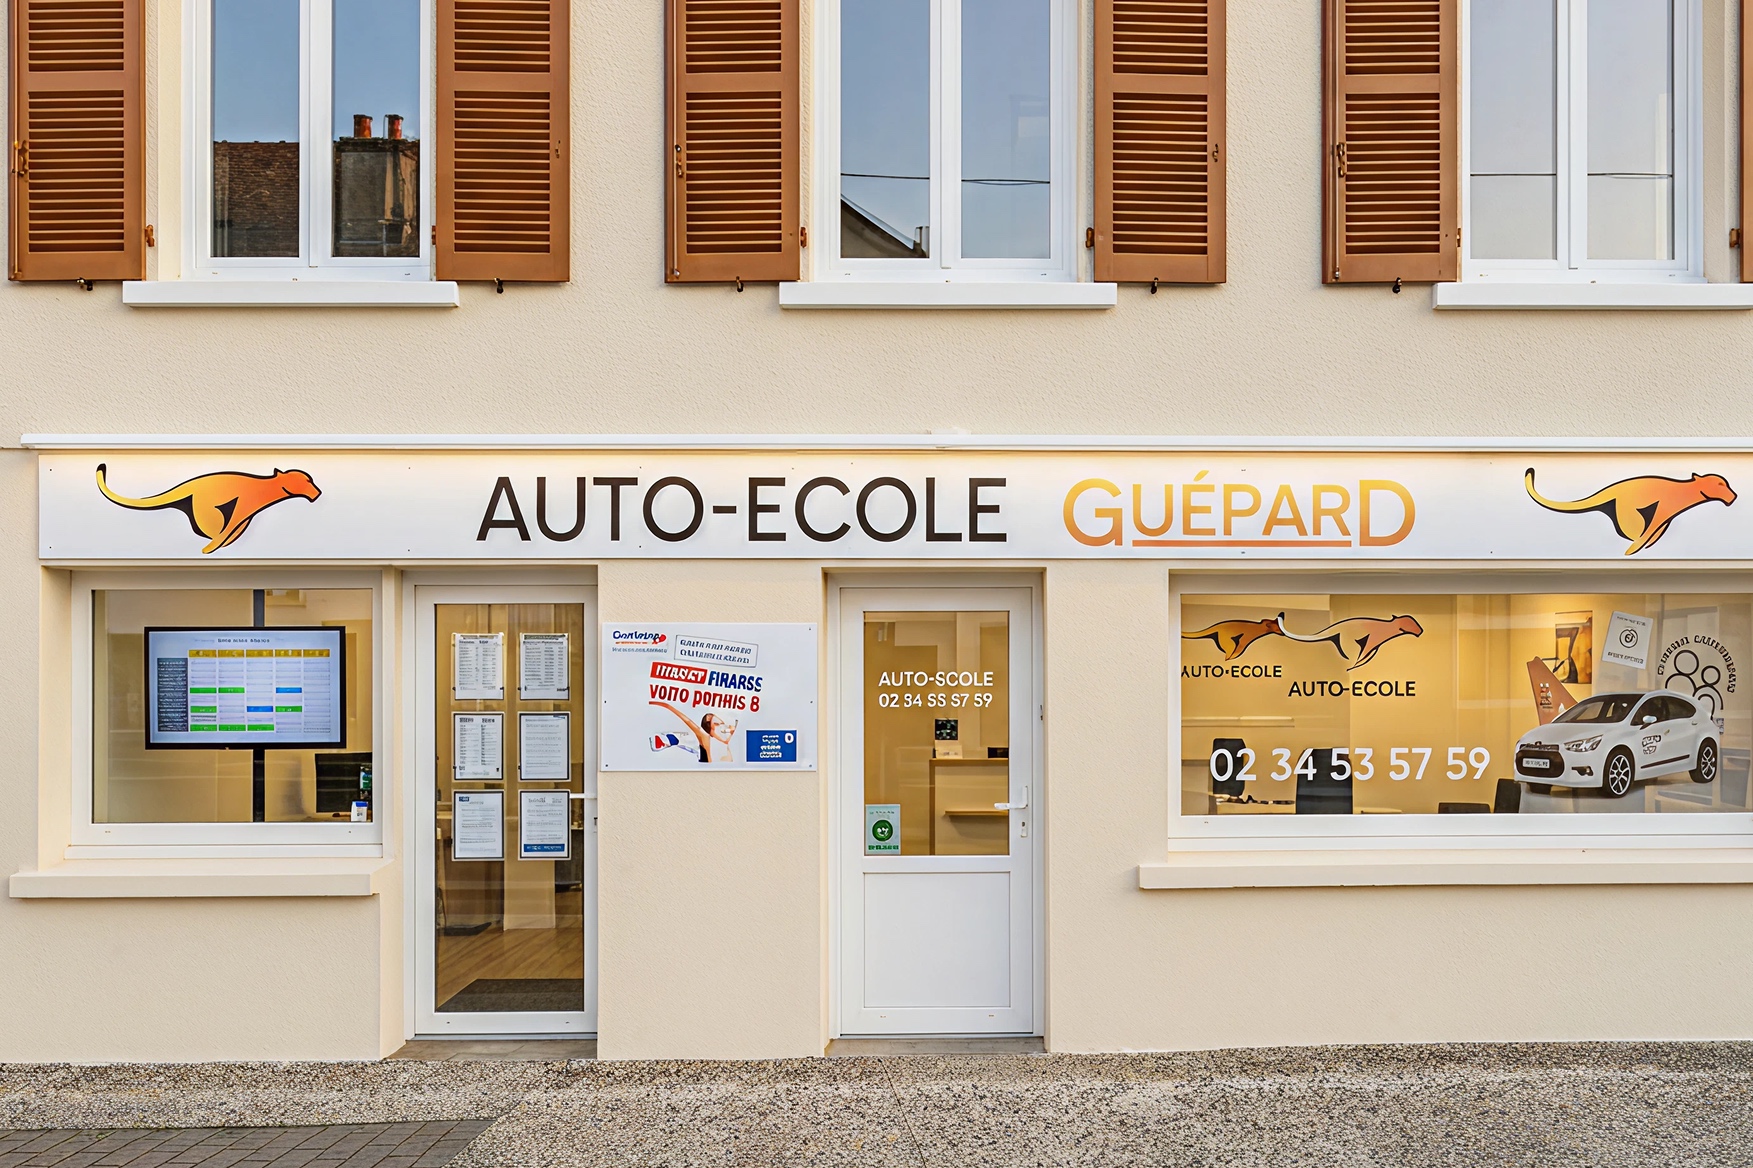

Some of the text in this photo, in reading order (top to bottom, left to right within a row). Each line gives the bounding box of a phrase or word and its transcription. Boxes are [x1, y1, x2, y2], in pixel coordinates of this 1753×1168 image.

[476, 469, 1416, 547] AUTO-ECOLE GUÉPARD
[878, 693, 900, 708] 02
[1288, 680, 1417, 697] AUTO-ECOLE
[1209, 746, 1491, 782] 02 34 53 57 59
